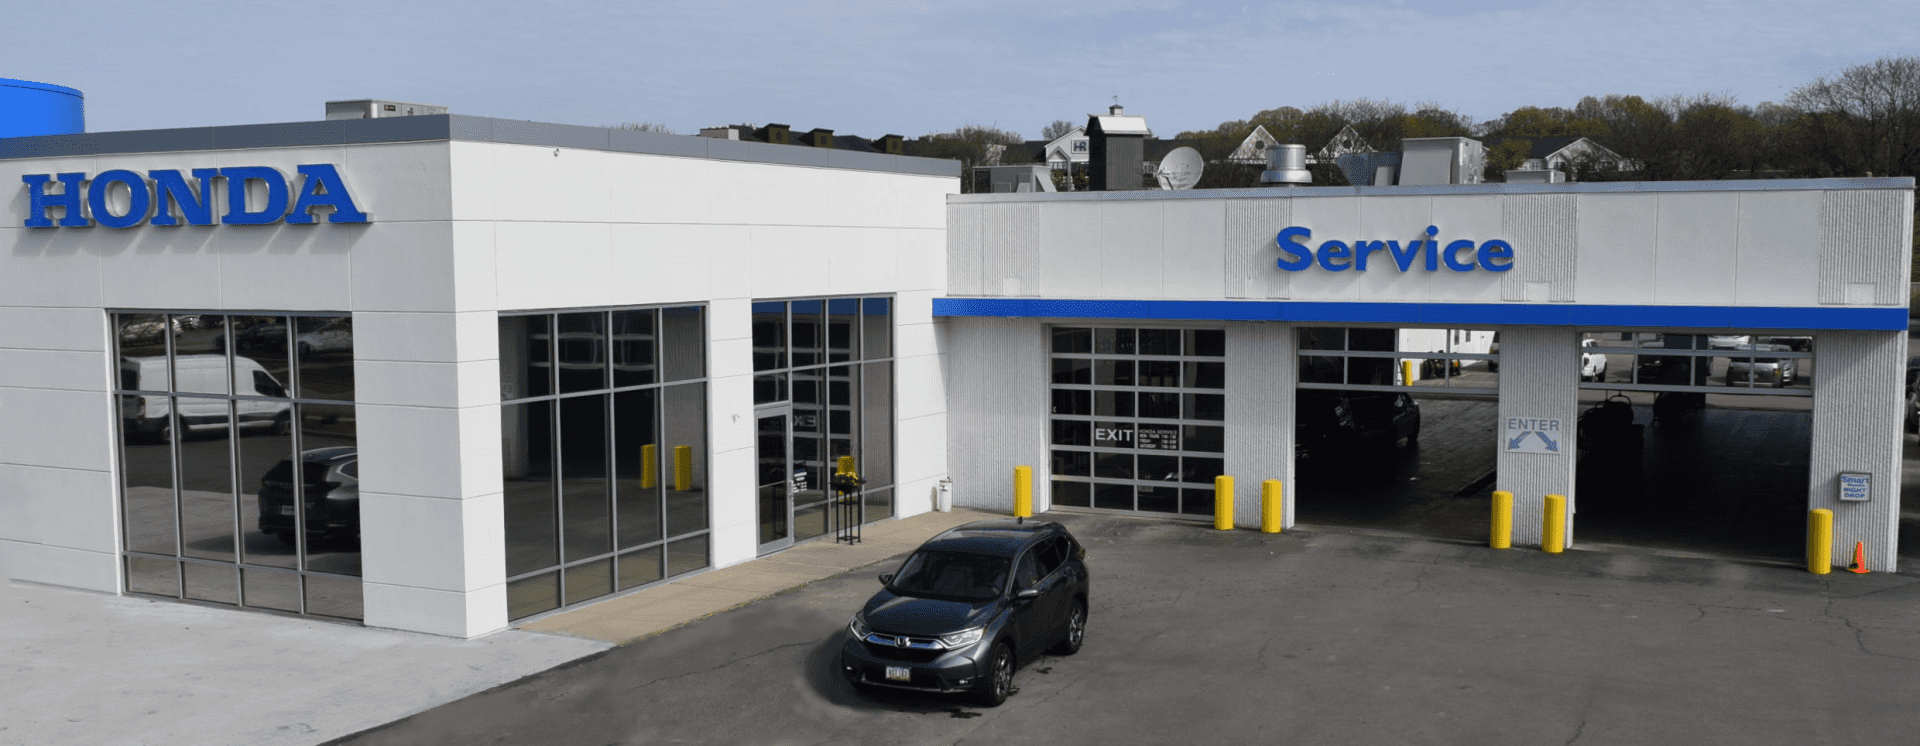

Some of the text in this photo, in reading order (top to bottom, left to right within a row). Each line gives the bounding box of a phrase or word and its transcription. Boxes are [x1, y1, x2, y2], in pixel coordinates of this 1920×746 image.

[22, 163, 371, 229] HONDA
[1276, 224, 1514, 273] Service
[1507, 418, 1560, 431] ENTER
[1095, 428, 1133, 441] EXIT
[1841, 475, 1869, 483] Smart
